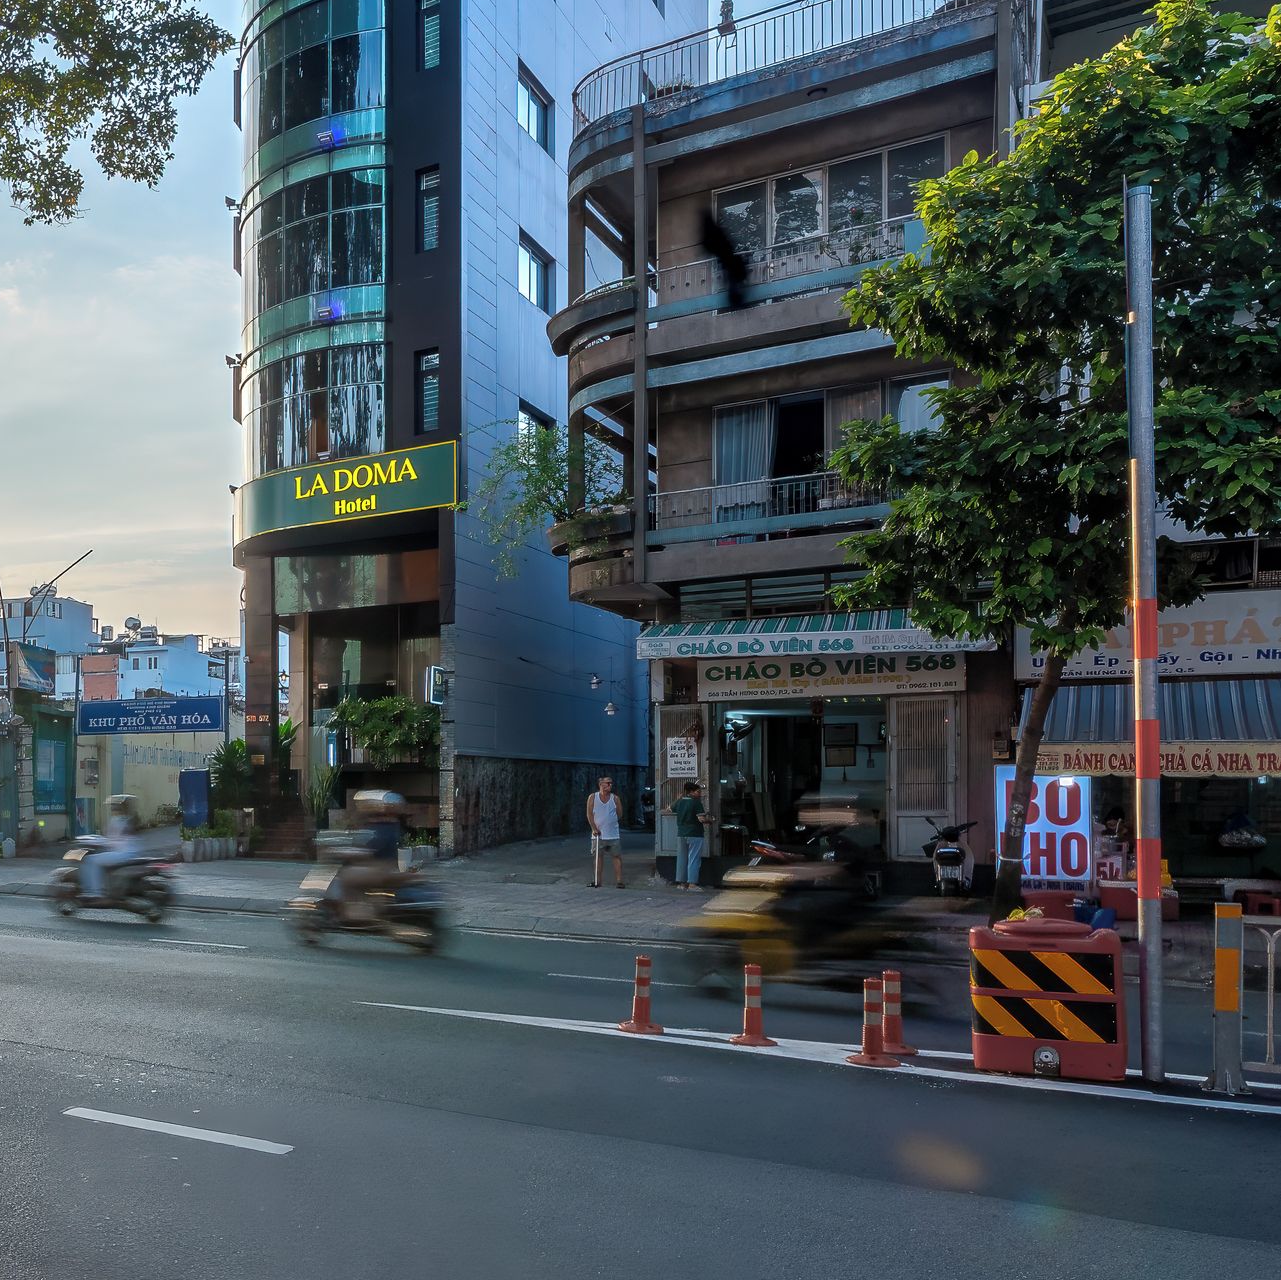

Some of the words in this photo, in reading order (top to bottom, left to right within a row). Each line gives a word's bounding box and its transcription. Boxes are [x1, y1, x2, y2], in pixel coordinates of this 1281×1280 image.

[294, 473, 329, 500] LA
[333, 457, 418, 493] DOMA
[334, 494, 377, 516] Hotel
[677, 639, 733, 656] CHÁO
[738, 638, 764, 654] BÒ
[769, 637, 813, 653] VIÊN
[818, 638, 854, 651] 568
[705, 661, 781, 682] CHÁO
[790, 657, 827, 678] BÒ
[835, 655, 896, 676] VIÊN
[905, 654, 956, 672] 568
[1093, 651, 1120, 668] Ép
[88, 718, 115, 728] KHU
[119, 713, 147, 726] PHỐ
[150, 714, 177, 725] VĂN
[181, 712, 211, 724] HÓA
[1063, 748, 1106, 771] BÁNH
[1108, 752, 1136, 771] CAN
[1191, 748, 1213, 770] CÁ
[1217, 752, 1253, 771] NHA
[1256, 752, 1281, 771] TR
